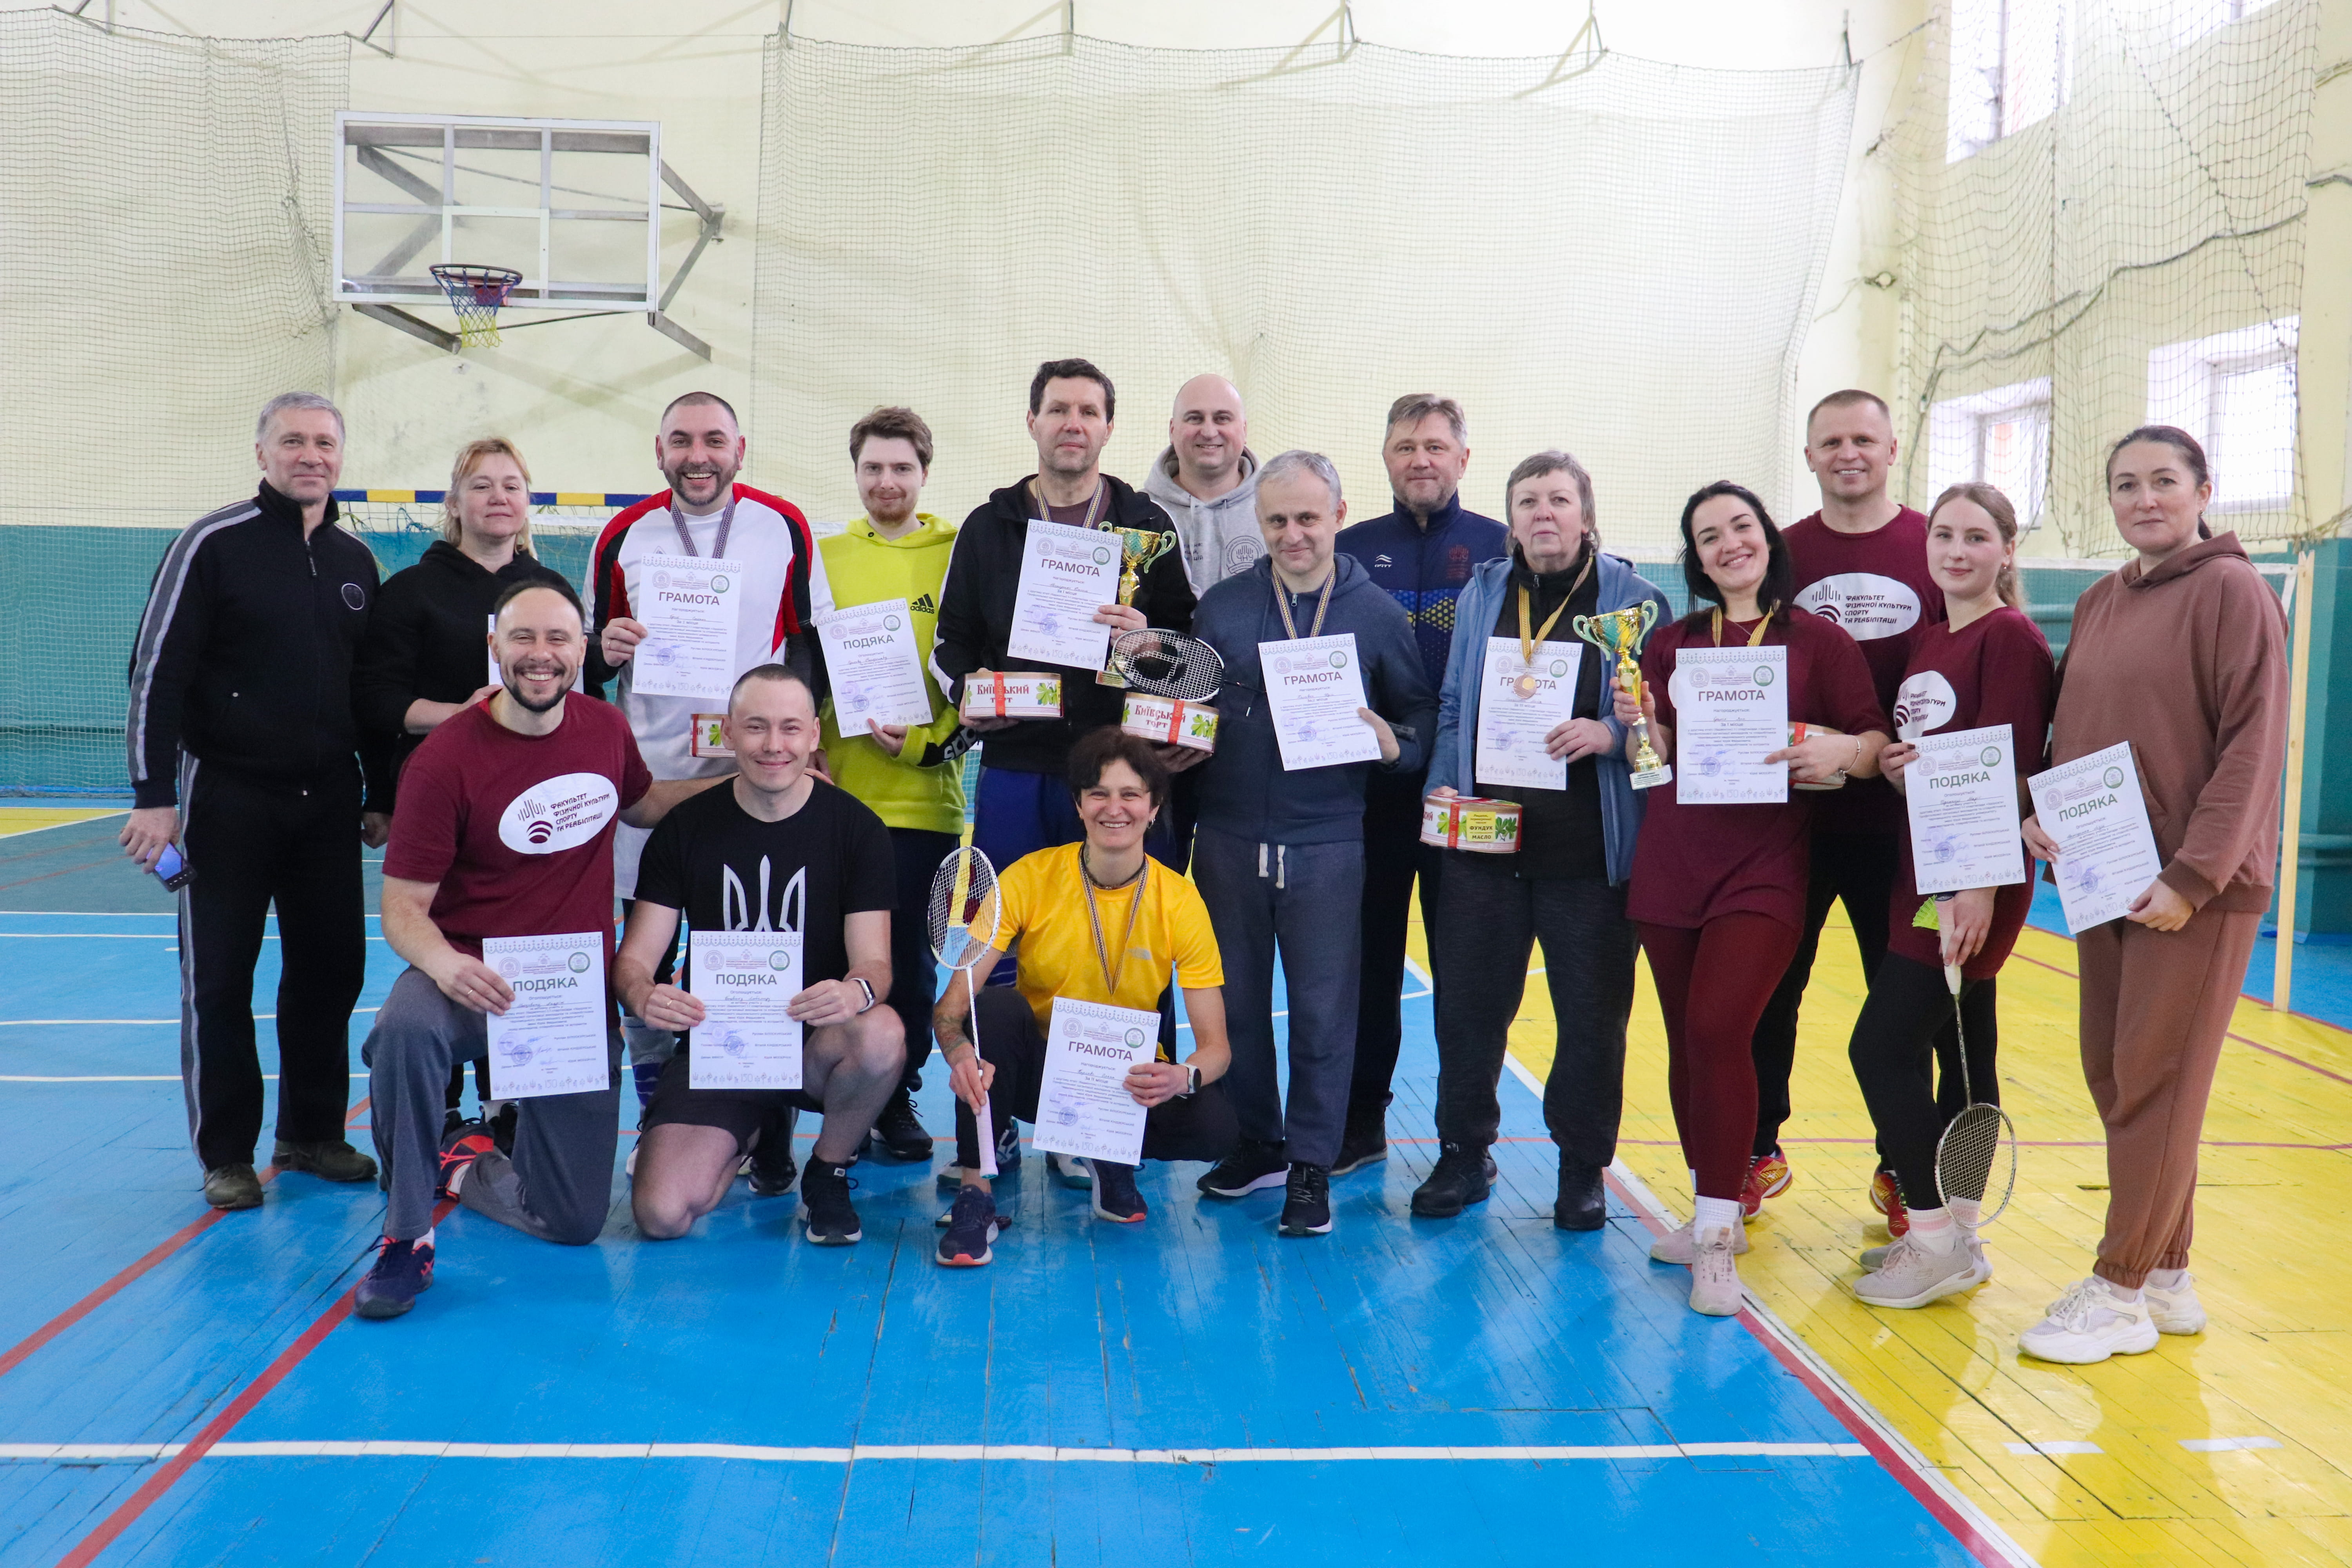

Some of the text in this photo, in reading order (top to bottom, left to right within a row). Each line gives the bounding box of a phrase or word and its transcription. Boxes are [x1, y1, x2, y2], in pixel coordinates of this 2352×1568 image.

[1041, 559, 1100, 577] ГРАМОТА
[659, 592, 720, 606] ГРАМОТА
[910, 604, 935, 614] adidas
[843, 635, 894, 650] ПОДЯКА
[1284, 671, 1343, 686] ГРАМОТА
[1500, 677, 1557, 690] ГРОТА
[977, 684, 1029, 695] Киїький
[1699, 690, 1765, 701] ГРАМОТА
[1174, 701, 1183, 717] ROSHE
[1146, 719, 1168, 728] торт
[1930, 770, 1990, 791] ПОДЯКА
[550, 793, 587, 809] ФАКУЛЬТЕТ
[553, 793, 610, 817] ФІЗИЧНОЇ КУЛЬТУРИ
[2058, 793, 2118, 822] ПОДЯКА
[555, 813, 577, 825] СПОРТУ
[512, 976, 578, 994] ПОДЯКА
[716, 974, 777, 986] ПОДЯКА
[1069, 1041, 1133, 1061] ГРАМОТА
